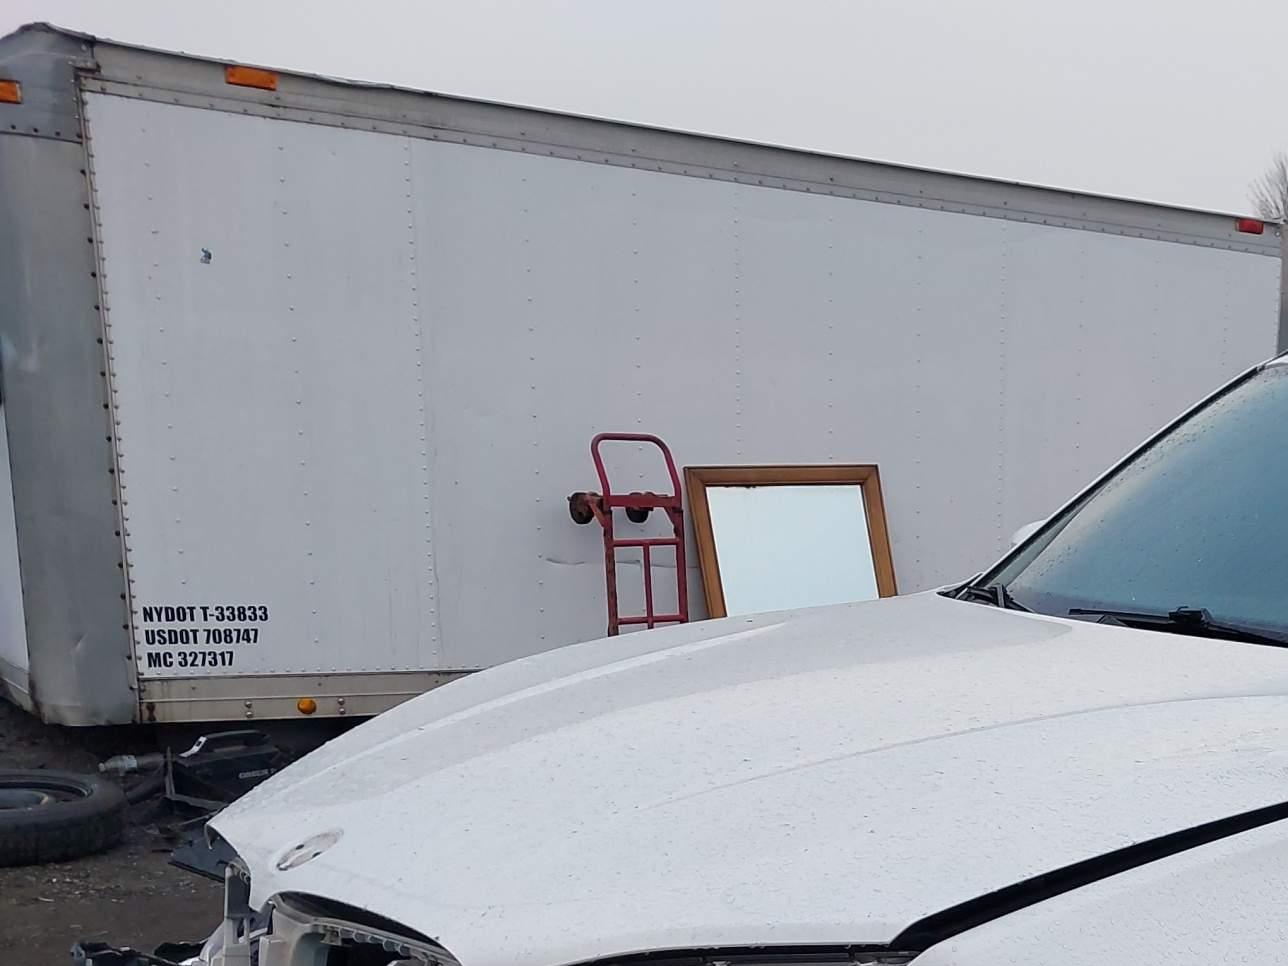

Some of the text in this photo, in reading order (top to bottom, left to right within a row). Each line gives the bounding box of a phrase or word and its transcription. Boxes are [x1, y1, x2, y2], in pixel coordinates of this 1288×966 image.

[142, 606, 269, 622] NYDOT T-33833
[144, 628, 259, 645] USDOT 708747
[147, 651, 234, 668] MC 327317
